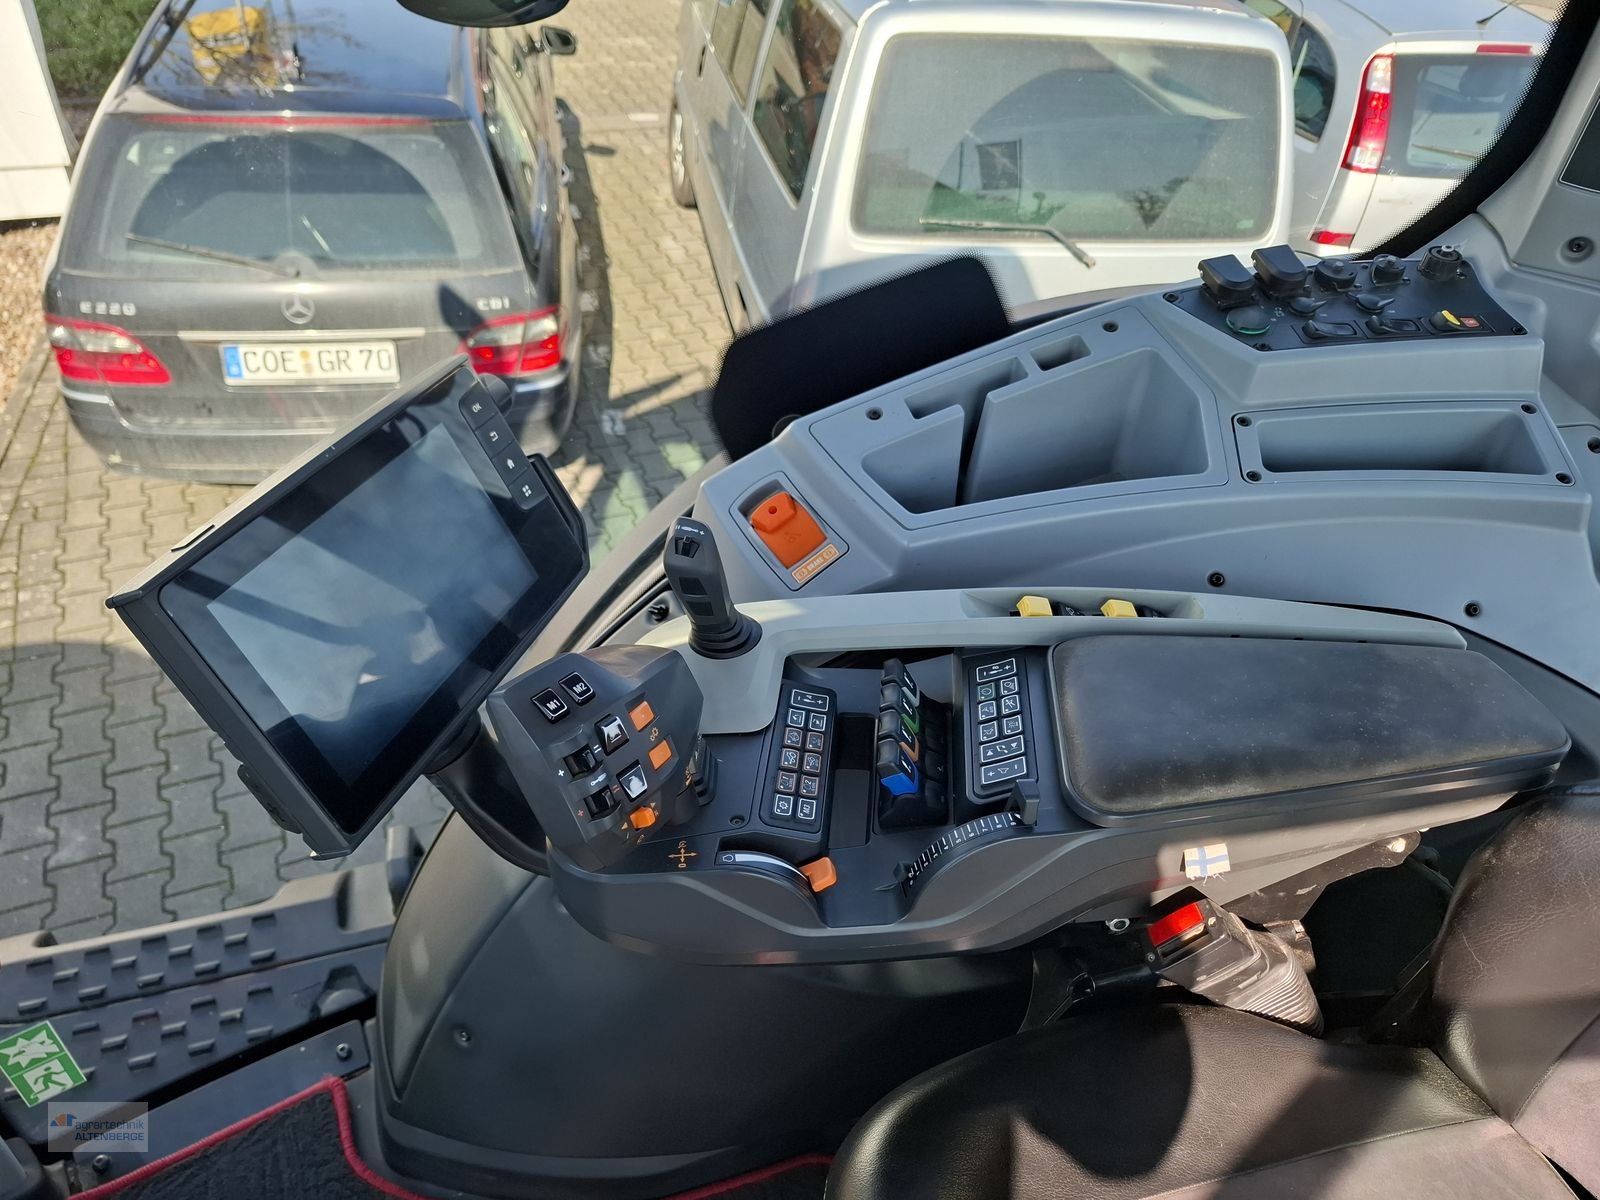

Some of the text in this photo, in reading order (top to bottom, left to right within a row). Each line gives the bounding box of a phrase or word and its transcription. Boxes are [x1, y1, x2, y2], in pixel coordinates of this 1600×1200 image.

[477, 297, 510, 310] CDI
[243, 350, 297, 373] COE
[318, 350, 351, 372] GR
[360, 349, 392, 371] 70
[472, 402, 482, 413] OK
[572, 682, 588, 694] M2
[546, 699, 561, 711] M1
